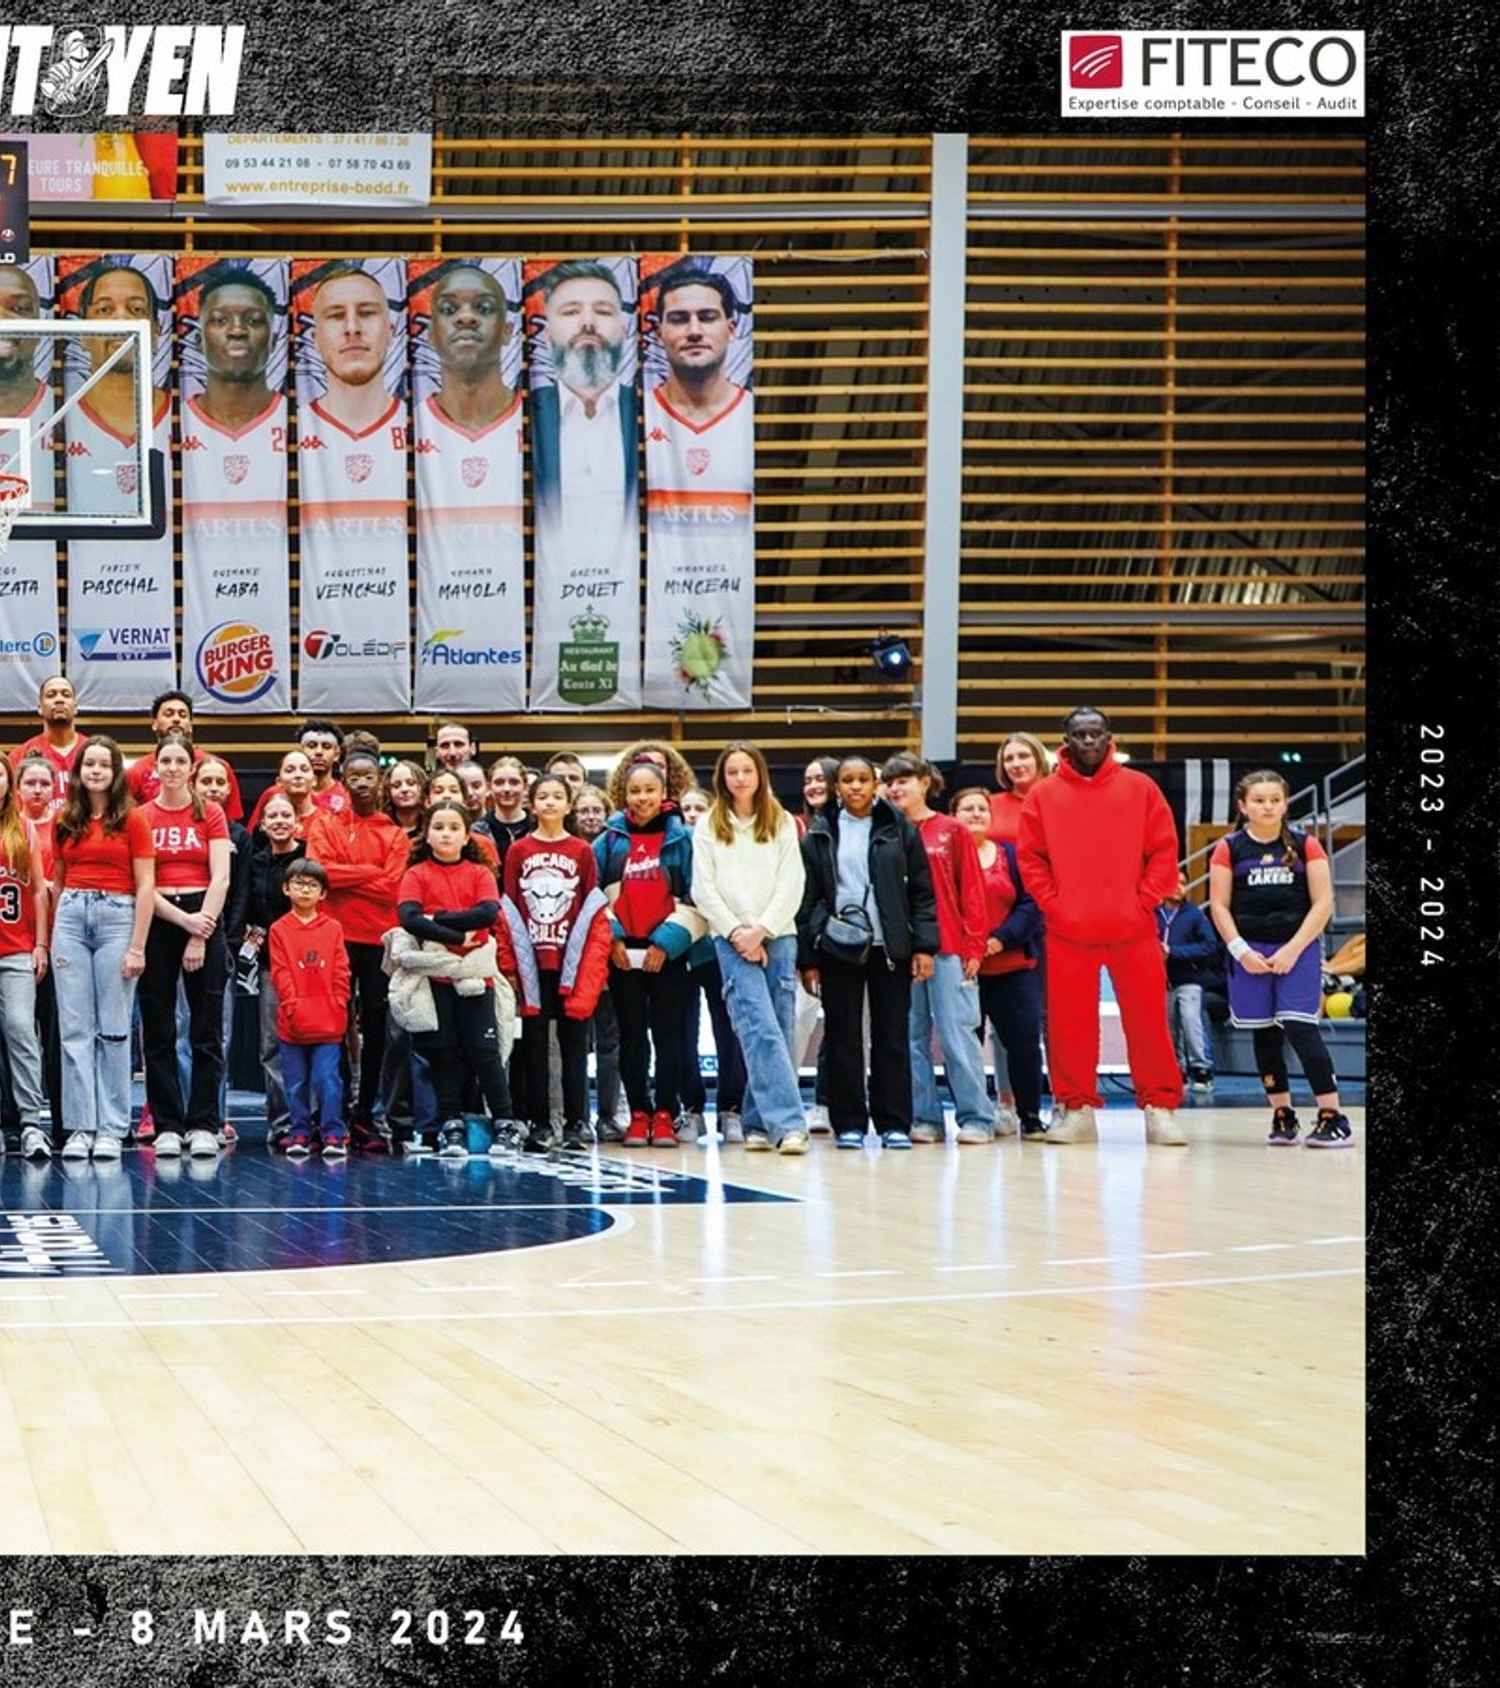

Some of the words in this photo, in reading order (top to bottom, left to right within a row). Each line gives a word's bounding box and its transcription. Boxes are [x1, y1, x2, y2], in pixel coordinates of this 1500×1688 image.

[29, 159, 59, 175] EURE
[66, 160, 145, 177] TRANQUILLE
[243, 159, 257, 168] 53
[261, 158, 275, 168] 44
[279, 158, 292, 168] 21
[39, 178, 82, 191] TOURS
[660, 504, 736, 524] ARTUS
[82, 577, 159, 596] PASCHAL
[215, 581, 260, 599] KABA
[316, 580, 398, 601] VENCKUS
[438, 581, 508, 601] MAYOLA
[560, 580, 624, 600] DOUET
[663, 577, 742, 597] MINCEAU
[109, 627, 171, 645] VERNAT
[204, 634, 271, 667] BURGER
[432, 643, 522, 666] Atlantes
[206, 649, 274, 690] KING
[150, 826, 202, 848] USA
[522, 852, 579, 878] CHICAGO
[1247, 871, 1295, 887] LAKERS
[528, 918, 570, 945] BULLS
